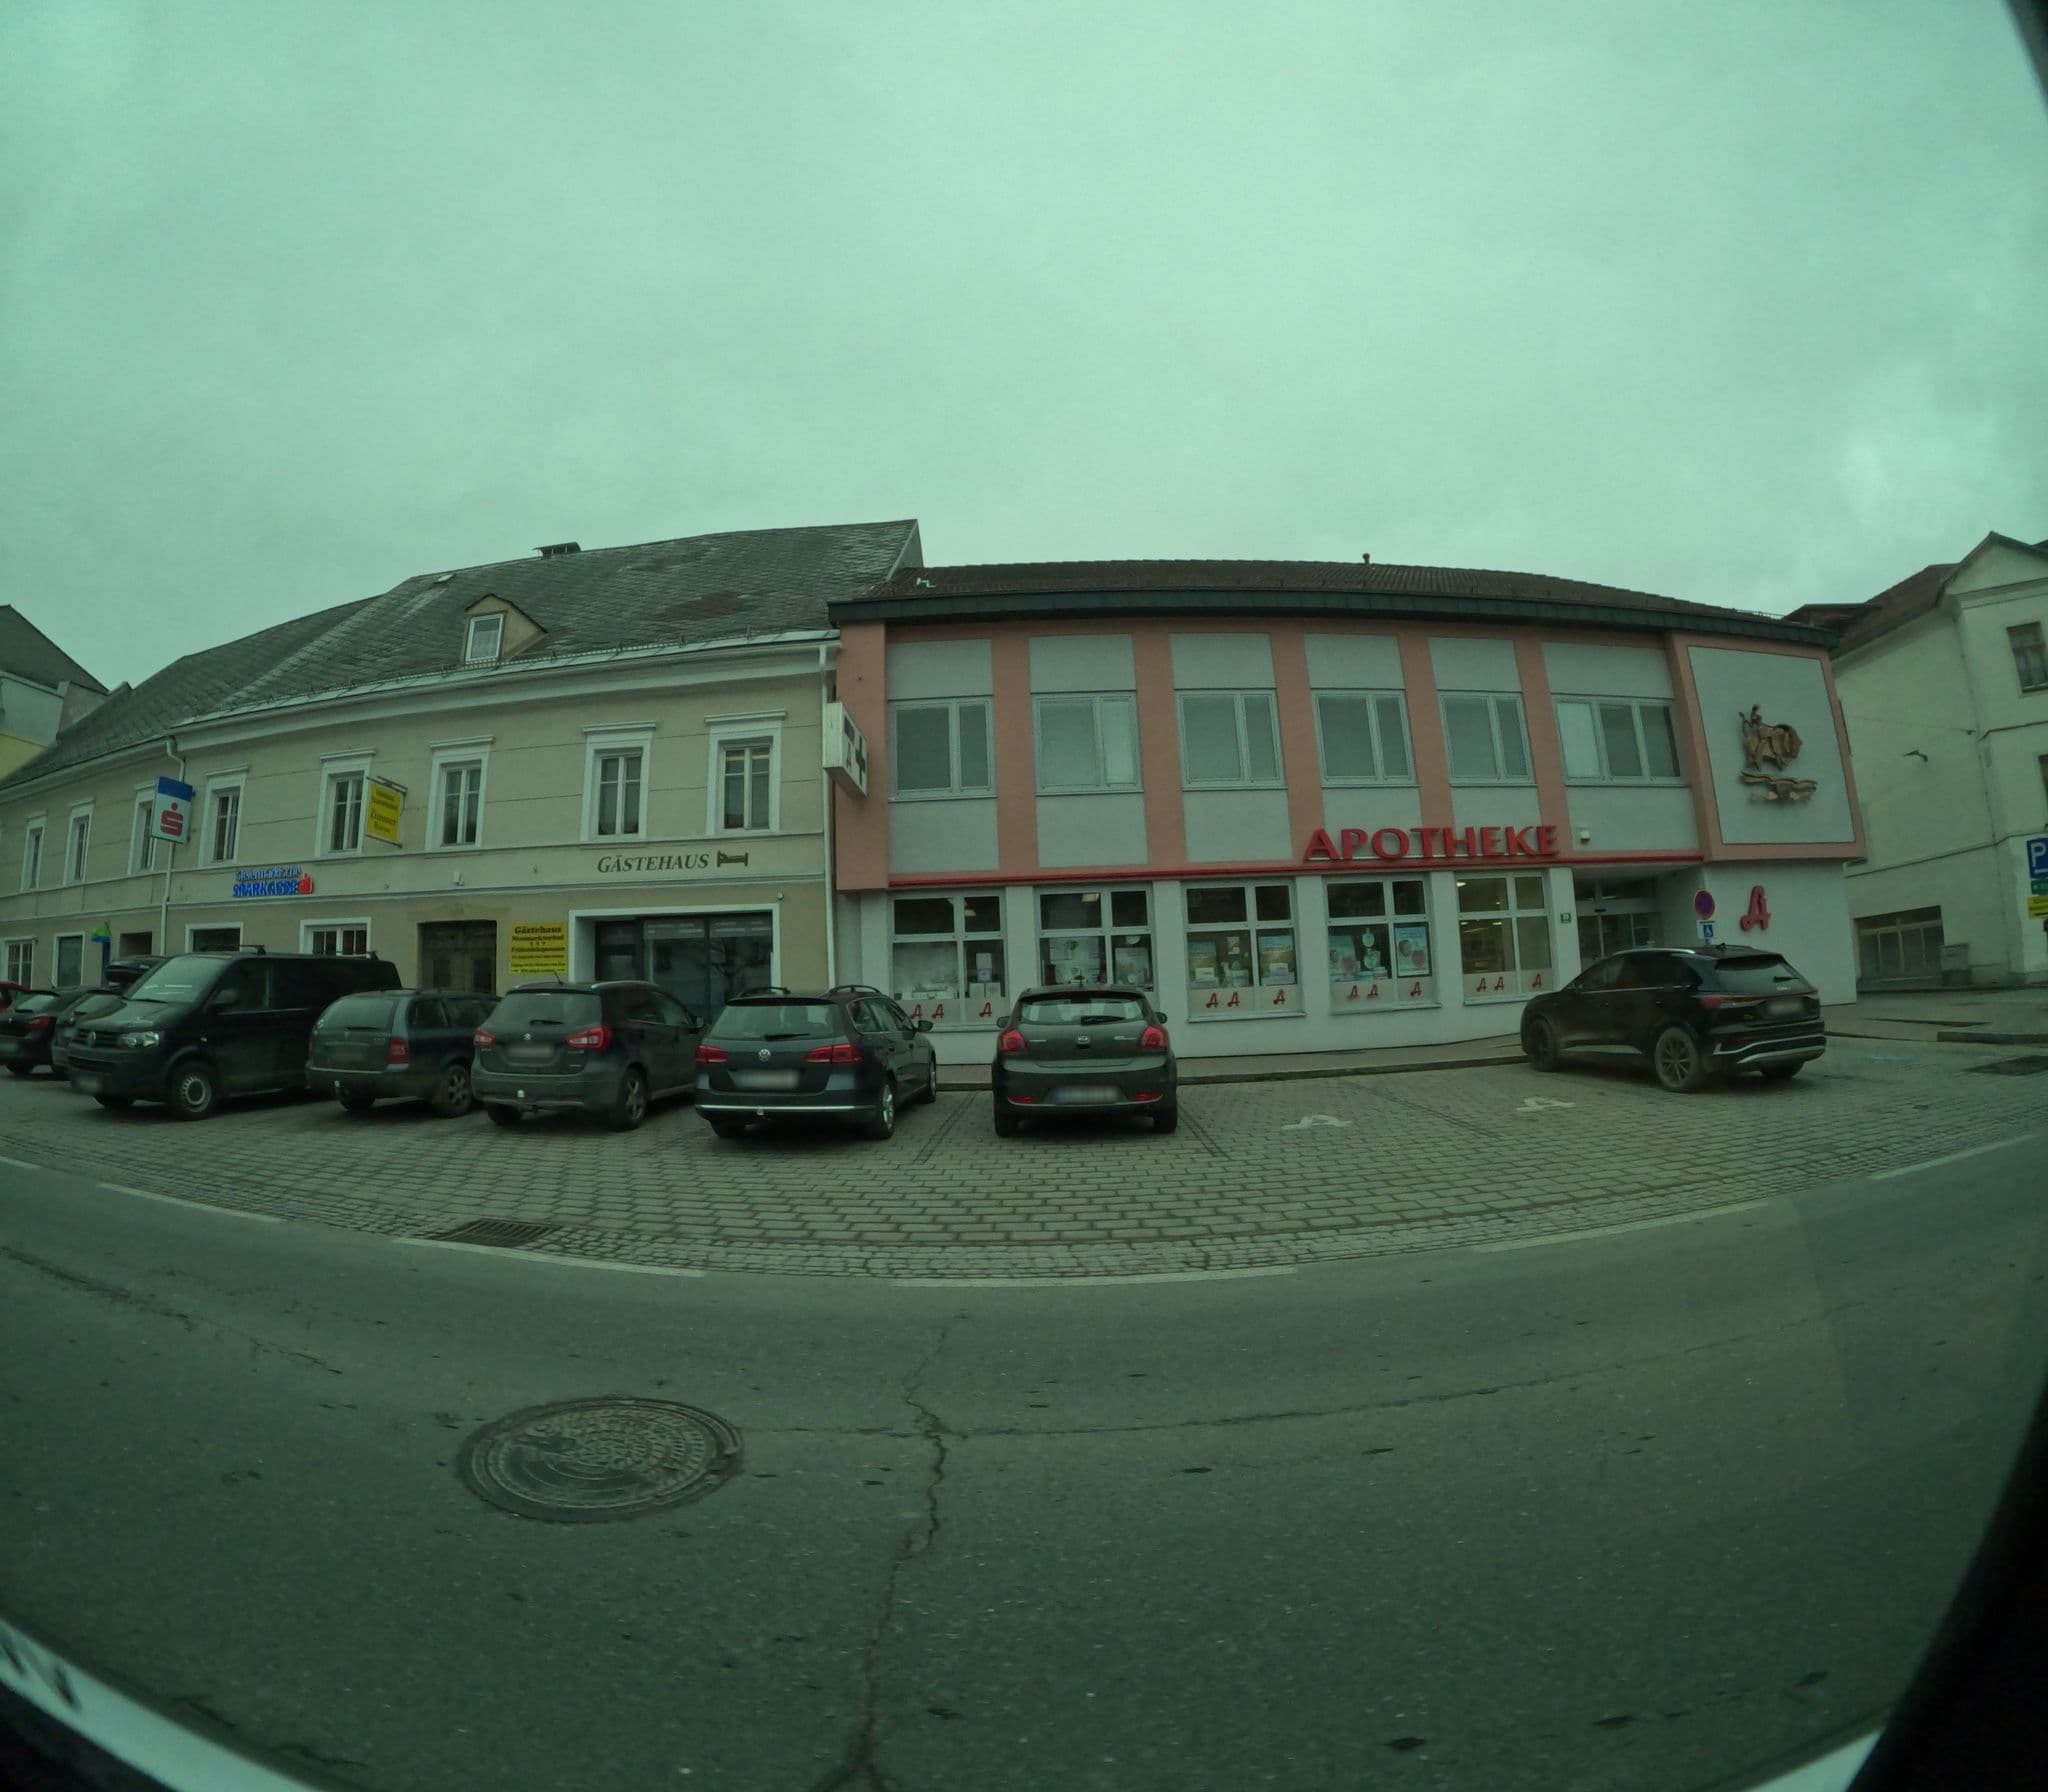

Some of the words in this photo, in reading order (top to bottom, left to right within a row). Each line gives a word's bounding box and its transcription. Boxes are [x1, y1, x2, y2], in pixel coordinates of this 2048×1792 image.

[1304, 825, 1559, 861] APOTHEKE
[2030, 842, 2046, 868] P
[597, 853, 709, 873] GÄSTEHAUS
[1739, 884, 1771, 931] A
